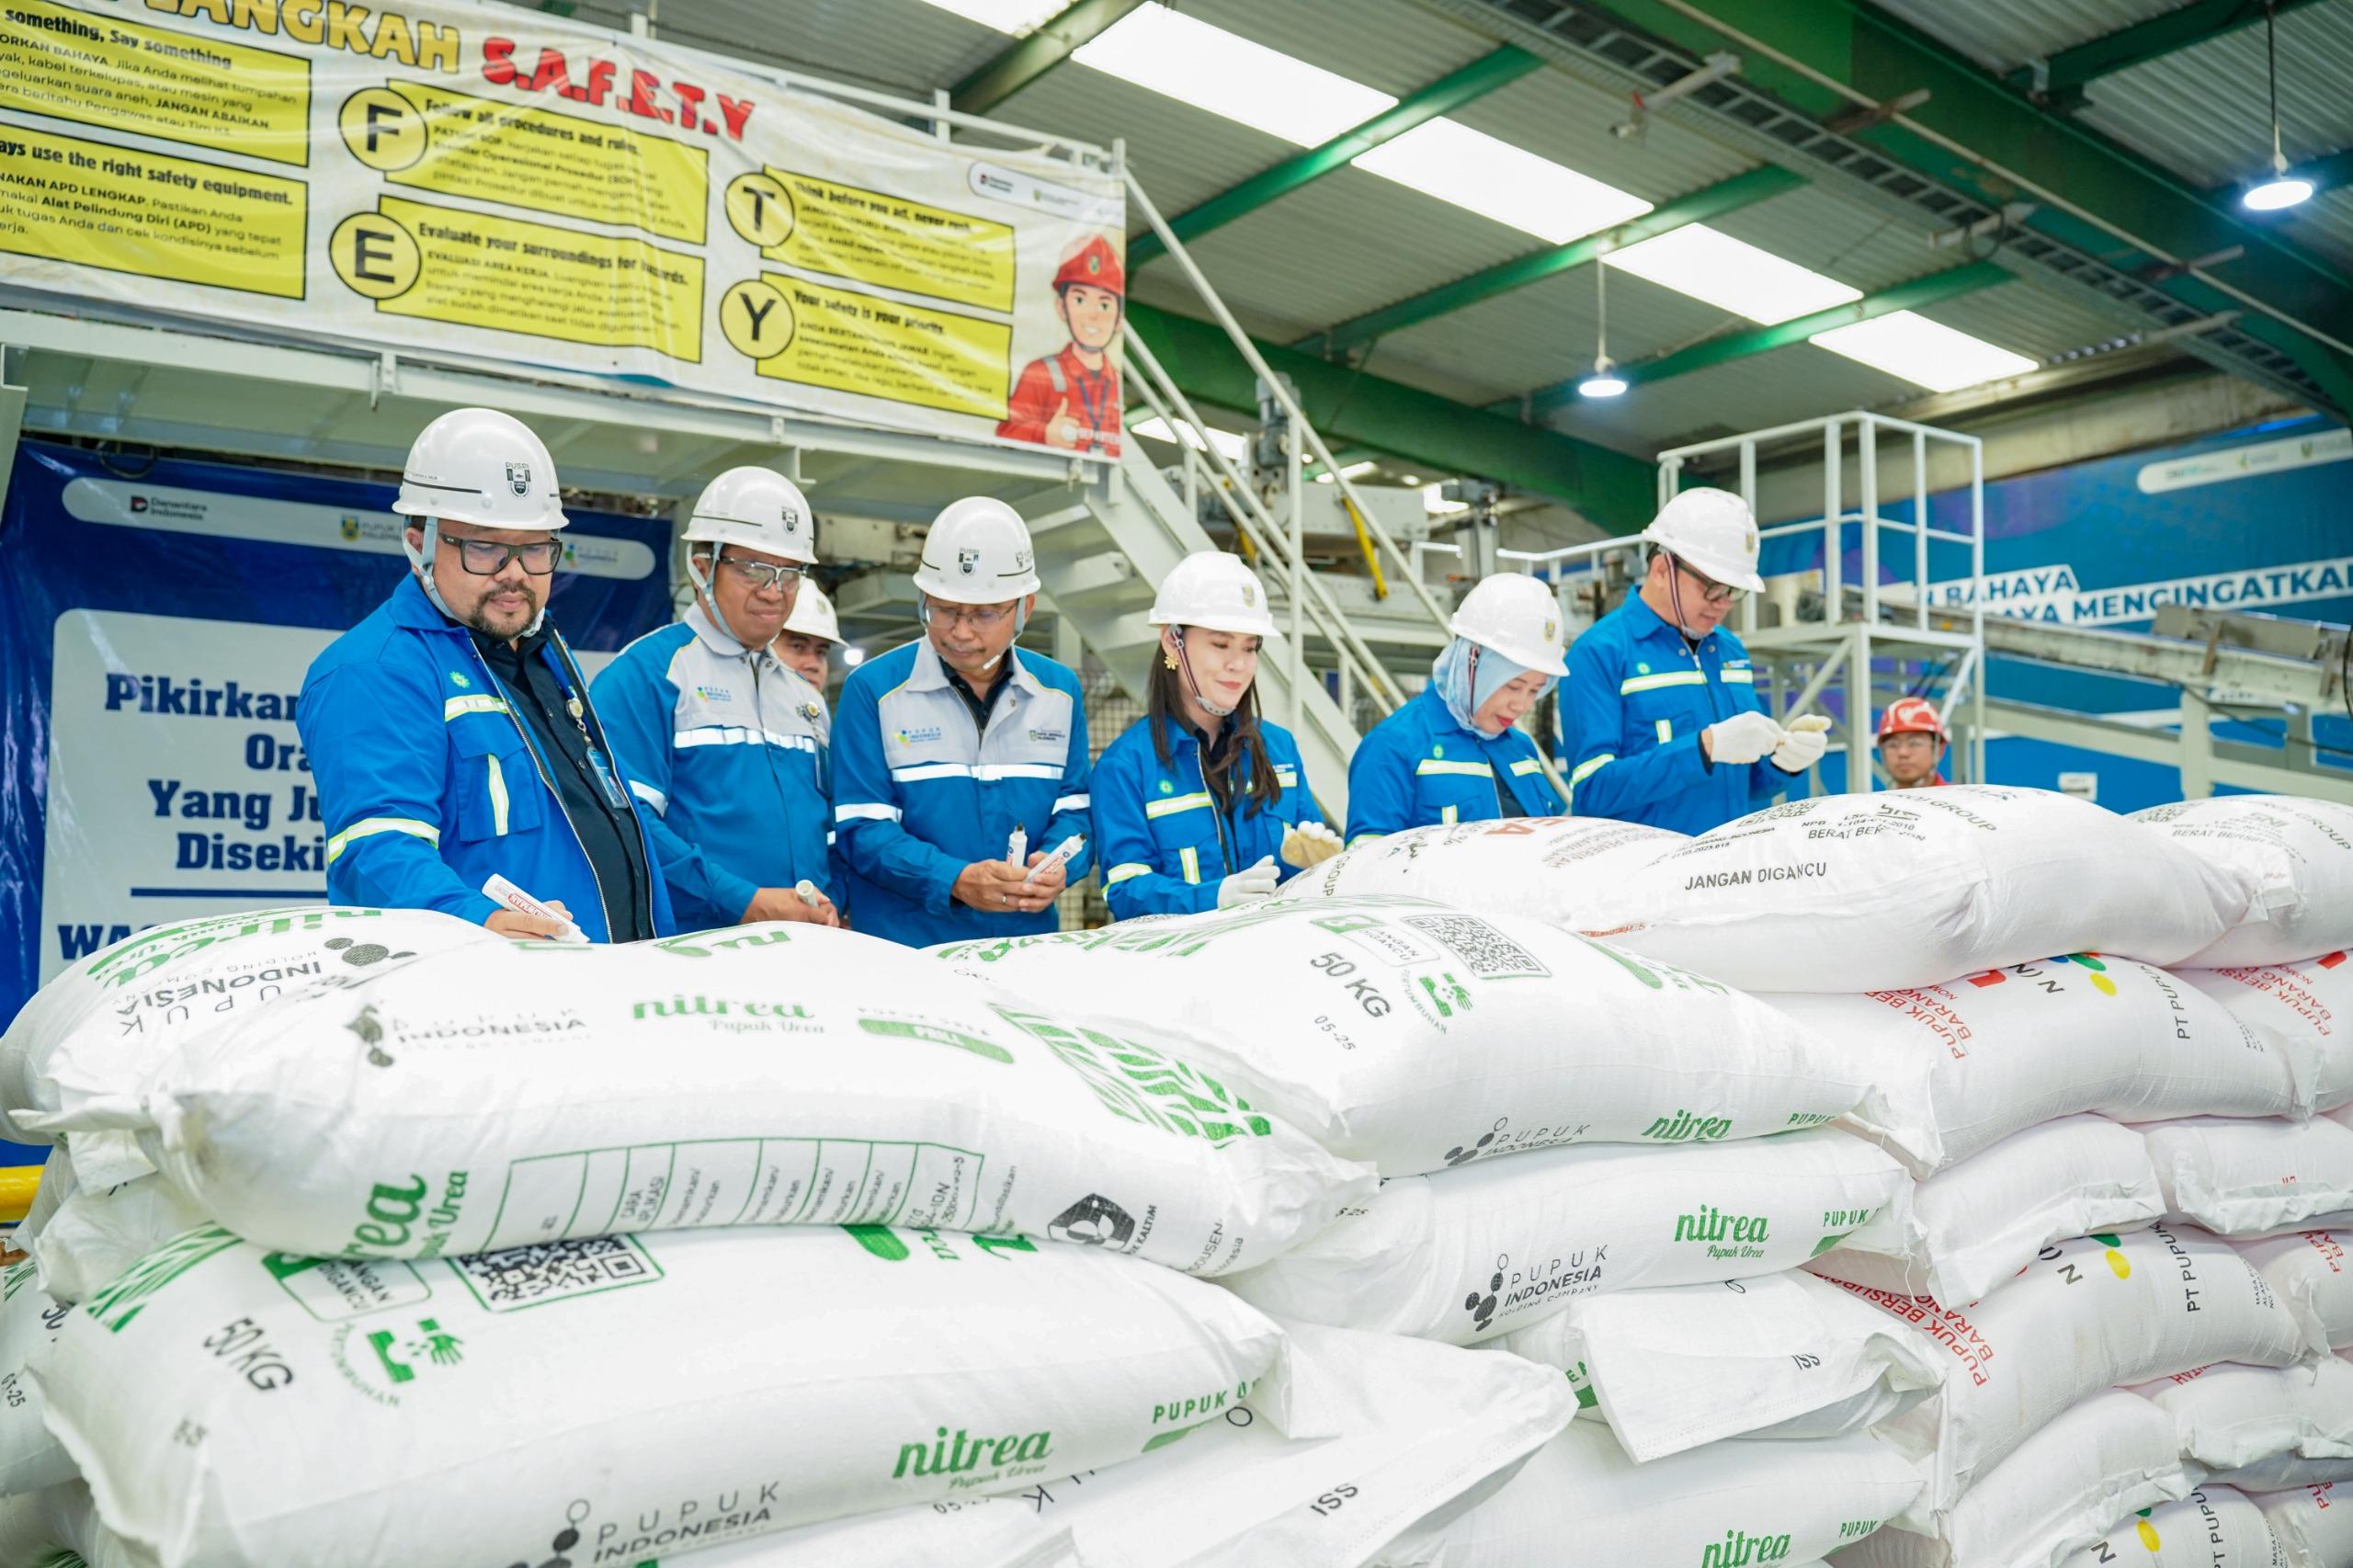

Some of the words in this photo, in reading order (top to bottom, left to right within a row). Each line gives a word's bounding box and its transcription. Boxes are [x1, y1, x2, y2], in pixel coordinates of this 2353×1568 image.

[5, 8, 105, 43] something,
[109, 28, 140, 49] Say
[143, 40, 233, 70] something
[28, 54, 67, 74] kabel
[179, 87, 220, 105] mesin
[222, 97, 253, 113] yang
[74, 82, 113, 99] suara
[155, 97, 210, 118] JANGAN
[143, 64, 177, 81] Anda
[180, 73, 230, 91] melihat
[366, 103, 404, 153] F
[31, 145, 64, 165] use
[68, 151, 97, 170] the
[101, 158, 143, 179] right
[147, 167, 199, 191] safety
[17, 208, 57, 224] tugas
[58, 215, 95, 230] Anda
[97, 222, 124, 234] dan
[40, 196, 71, 210] Alat
[73, 200, 144, 223] Pelindung
[146, 213, 171, 227] Diri
[173, 217, 212, 234] (APD)
[214, 226, 246, 242] yang
[49, 180, 79, 195] APD
[210, 208, 244, 223] Anda
[743, 184, 777, 233] T
[828, 190, 867, 210] before
[355, 228, 395, 283] E
[418, 222, 483, 247] Evaluate
[485, 236, 518, 252] your
[521, 242, 614, 269] surroundings
[617, 255, 638, 271] for
[738, 291, 777, 341] Y
[874, 310, 903, 325] your
[2071, 557, 2353, 628] MENGINGATKA
[146, 778, 273, 832] Yang
[1684, 869, 1754, 892] JANGAN
[1756, 860, 1829, 885] DIGANCU
[114, 960, 324, 1017] INDONESIA
[632, 993, 816, 1020] nitrea
[1310, 951, 1358, 978] 50
[1343, 977, 1392, 1018] KG
[1313, 1014, 1358, 1051] 05-25
[1905, 1005, 1967, 1061] PUPUK
[2175, 1015, 2191, 1040] PT
[2273, 990, 2332, 1038] PUPUK
[1494, 1124, 1591, 1147] PUPUK
[1640, 1108, 1733, 1142] nitrea
[1673, 1203, 1771, 1244] nitrea
[1823, 1208, 1870, 1229] PUPUK
[1509, 1243, 1609, 1290] PUPUK
[1706, 1244, 1740, 1262] Pupuk
[2056, 1263, 2085, 1287] N
[1504, 1265, 1603, 1309] INDONESIA
[2186, 1288, 2202, 1312] PT
[228, 1346, 295, 1392] KG
[1923, 1318, 1988, 1388] PUPUK
[1152, 1391, 1229, 1426] PUPUK
[891, 1425, 1055, 1481] nitrea
[597, 1480, 782, 1547] PUPUK
[1309, 1481, 1360, 1518] ISS
[591, 1506, 774, 1564] INDONESIA
[1700, 1528, 1792, 1568] nitrea
